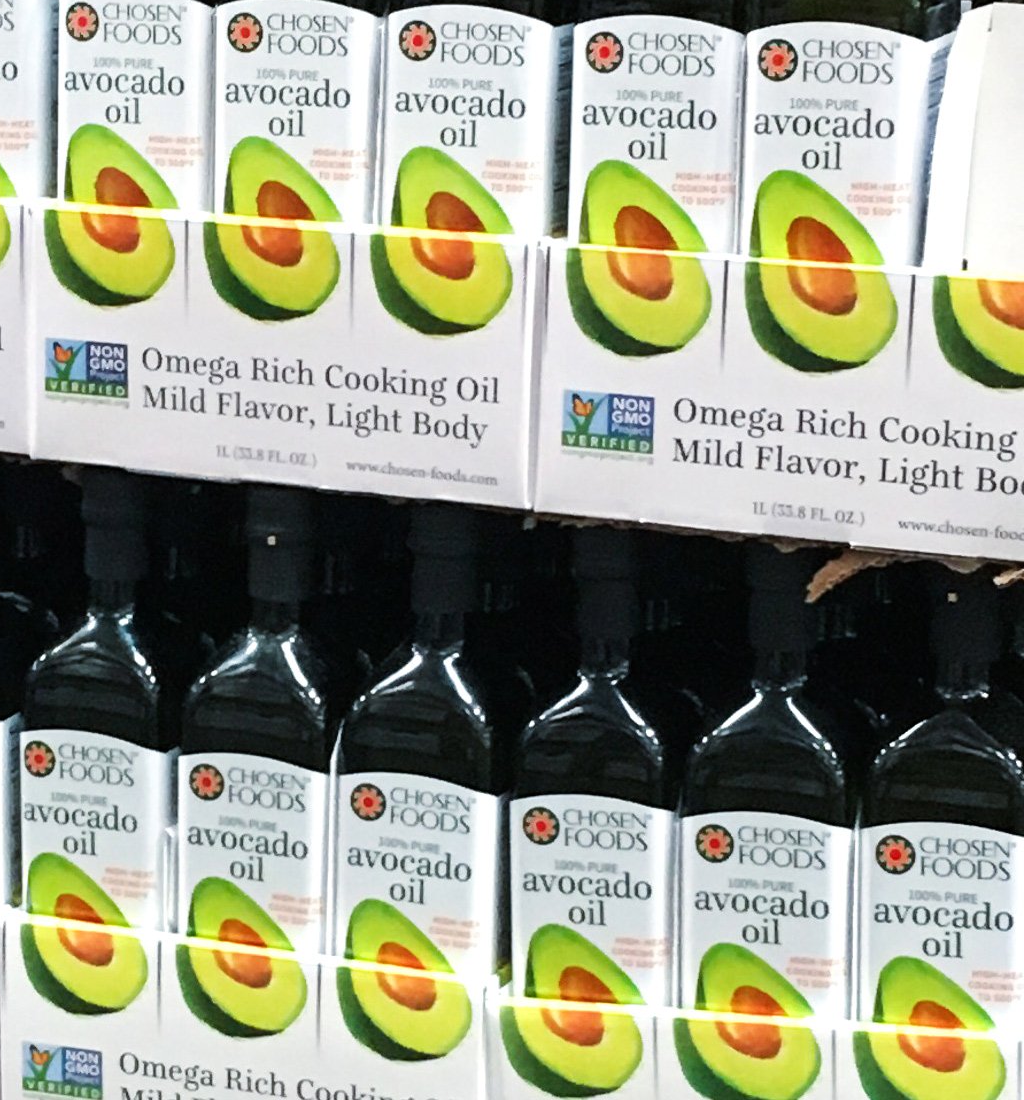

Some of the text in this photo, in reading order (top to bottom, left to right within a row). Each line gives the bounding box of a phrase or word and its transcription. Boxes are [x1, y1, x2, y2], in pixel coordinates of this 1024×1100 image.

[441, 42, 524, 66] FOODS
[629, 53, 715, 77] FOODS
[803, 60, 893, 84] FOODS
[395, 89, 526, 119] avocado
[651, 90, 683, 103] PURE
[825, 99, 858, 111] PURE
[583, 100, 717, 130] avocado
[754, 108, 894, 138] avocado
[440, 120, 476, 147] oil
[628, 132, 667, 160] oil
[802, 142, 841, 170] oil
[90, 345, 125, 359] NON
[89, 359, 126, 373] GMO
[142, 348, 498, 407] Omega Rich Cooking Oil
[48, 380, 127, 397] VERIFIED
[144, 385, 206, 413] Mild
[218, 392, 315, 428] Flavor,
[328, 403, 401, 437] Light
[413, 412, 487, 448] Body
[613, 398, 651, 412] NON
[612, 411, 651, 426] GMO
[674, 398, 1017, 461] Omega Rich Cooking
[566, 435, 650, 452] VERIFIED
[673, 438, 743, 468] Mild
[756, 445, 865, 484] Flavor,
[879, 458, 963, 494] Light
[976, 468, 1024, 495] Bo
[898, 520, 1024, 541] www.chosen-foo
[390, 805, 470, 834] FOODS
[347, 844, 472, 883] avocado
[739, 845, 826, 870] FOODS
[921, 856, 1011, 881] FOODS
[390, 879, 424, 905] oil
[695, 887, 829, 919] avocado
[874, 894, 1014, 931] avocado
[742, 919, 780, 945] oil
[922, 932, 962, 958] oil
[120, 1053, 214, 1093] Omega
[226, 1068, 287, 1097] Rich
